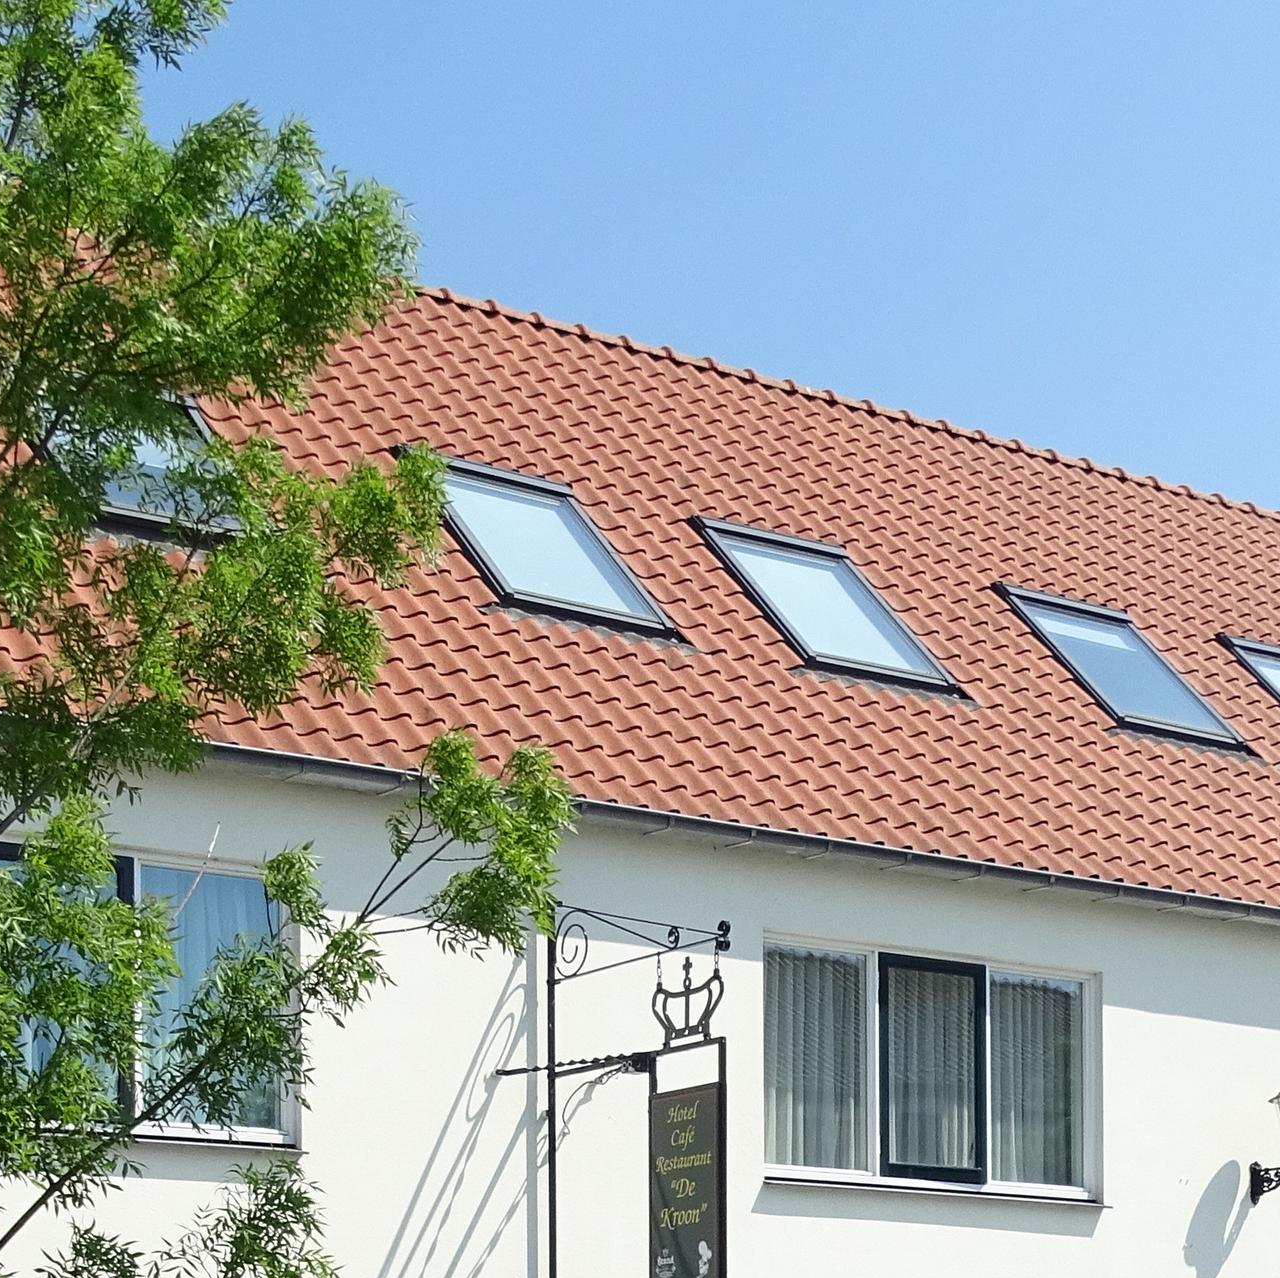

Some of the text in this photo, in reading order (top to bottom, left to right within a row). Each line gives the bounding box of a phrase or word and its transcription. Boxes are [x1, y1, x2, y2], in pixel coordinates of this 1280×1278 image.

[667, 1100, 699, 1123] Hotel
[671, 1125, 696, 1151] Café
[656, 1151, 711, 1174] Restaurant
